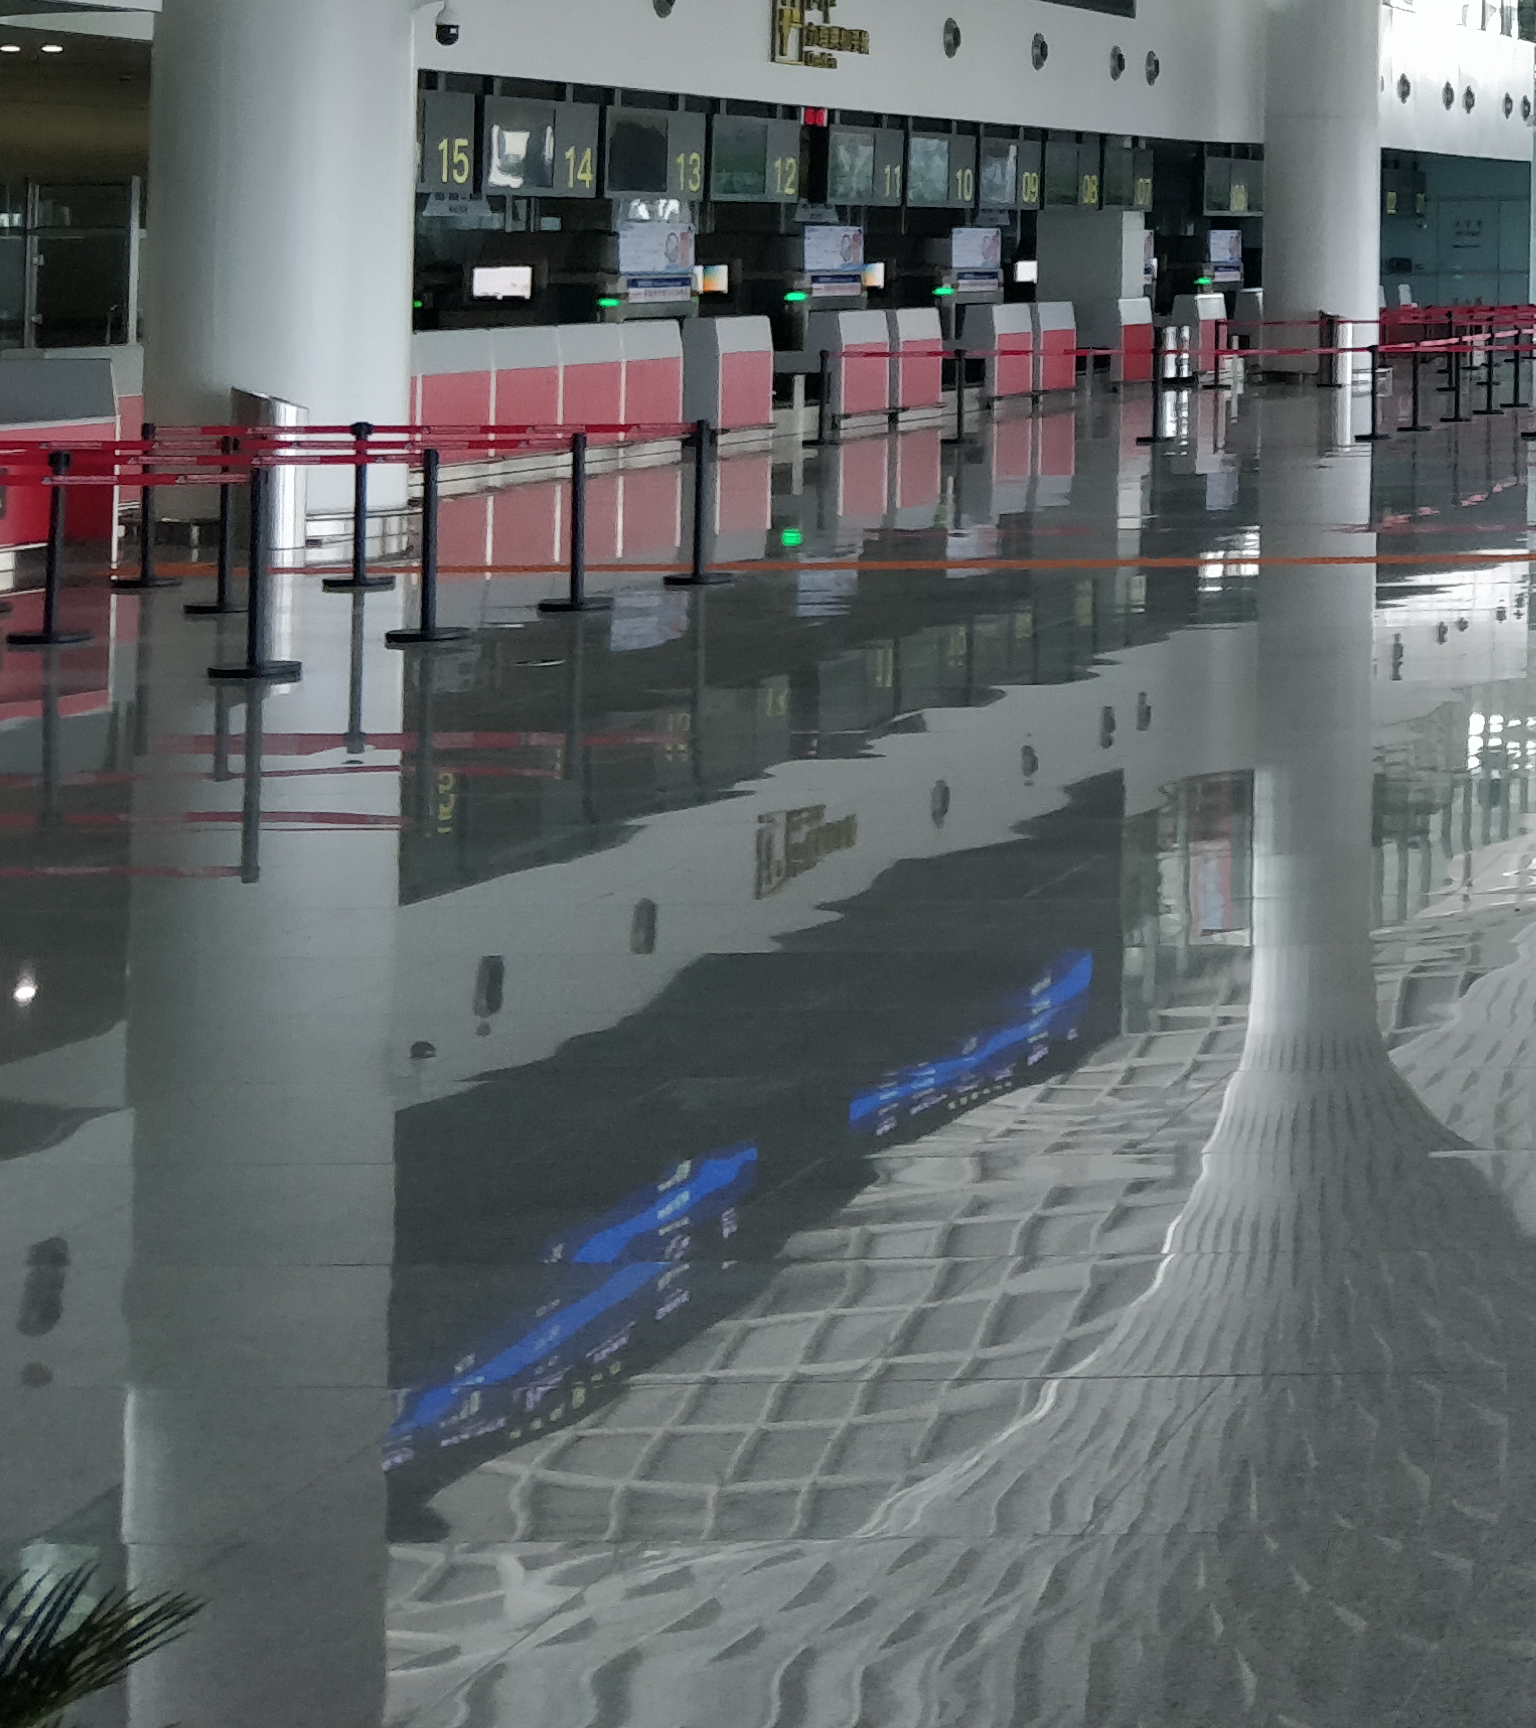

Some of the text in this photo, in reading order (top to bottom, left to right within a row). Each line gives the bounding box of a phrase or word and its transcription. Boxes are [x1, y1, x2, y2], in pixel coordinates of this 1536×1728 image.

[437, 138, 469, 185] 15
[565, 145, 593, 189] 14
[676, 152, 701, 192] 13
[774, 156, 797, 195] 12
[884, 164, 900, 198] 11
[955, 168, 973, 201] 10
[1022, 171, 1039, 204] 09
